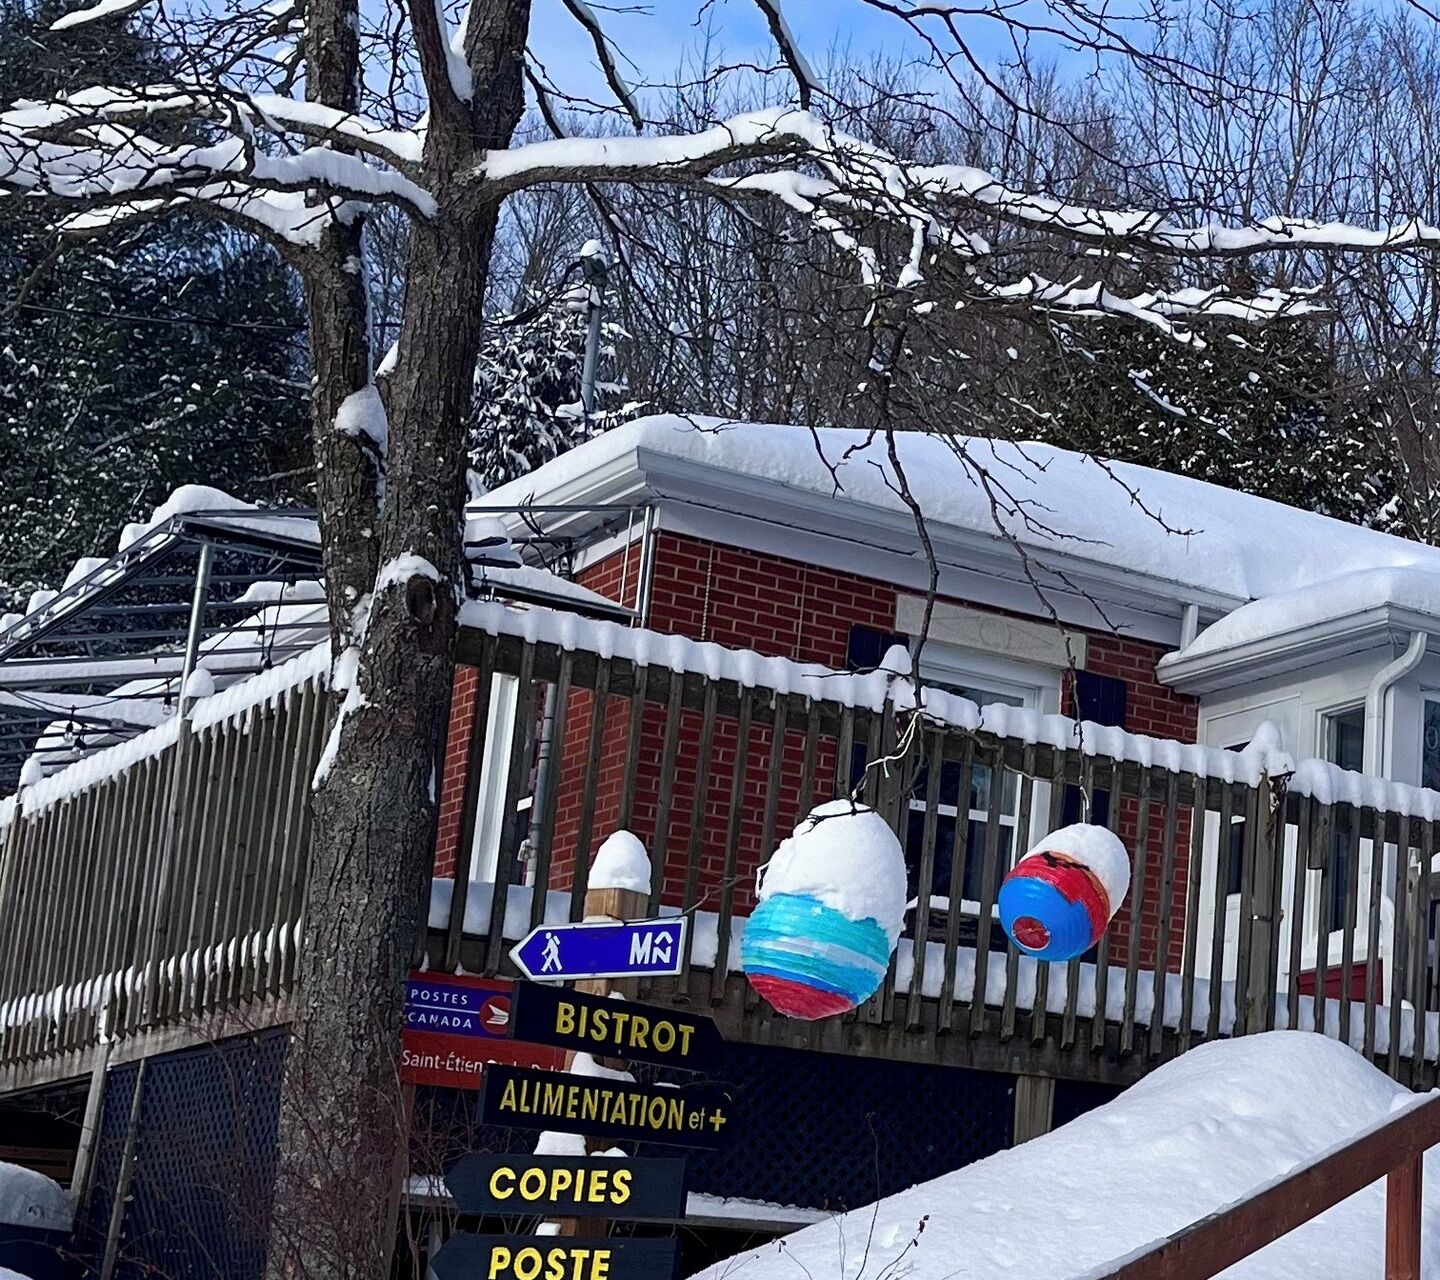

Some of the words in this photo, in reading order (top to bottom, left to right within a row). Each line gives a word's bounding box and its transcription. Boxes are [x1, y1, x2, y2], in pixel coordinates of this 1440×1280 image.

[411, 989, 468, 1005] POSTES
[408, 1011, 472, 1029] CANADA
[556, 1002, 695, 1056] BISTROT
[500, 1079, 685, 1131] ALIMENTATION
[689, 1110, 705, 1130] et
[489, 1167, 632, 1204] COPIES
